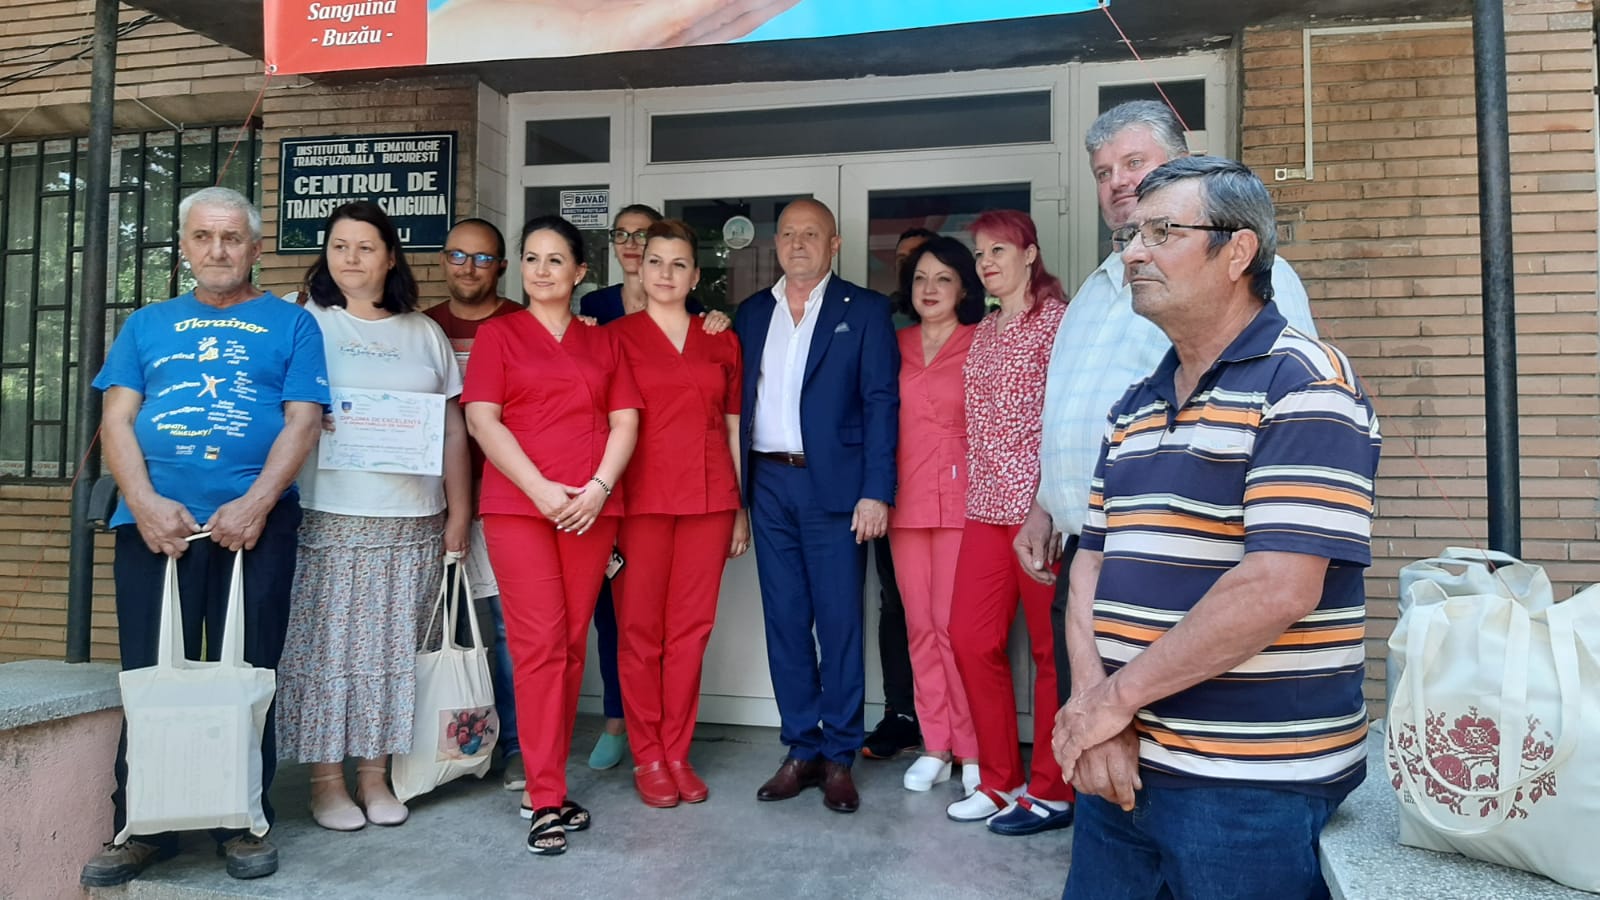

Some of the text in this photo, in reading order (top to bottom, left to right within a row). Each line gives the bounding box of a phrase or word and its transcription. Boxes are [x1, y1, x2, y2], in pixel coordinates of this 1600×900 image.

[321, 26, 382, 47] Buzău
[296, 140, 440, 156] INSTITUTUL DE HEMATOLOGIE
[293, 154, 375, 167] TRANSFUZIONALA
[294, 171, 438, 195] CENTRUL DE
[286, 197, 368, 219] TRANSF
[174, 317, 269, 334] Ukrainer
